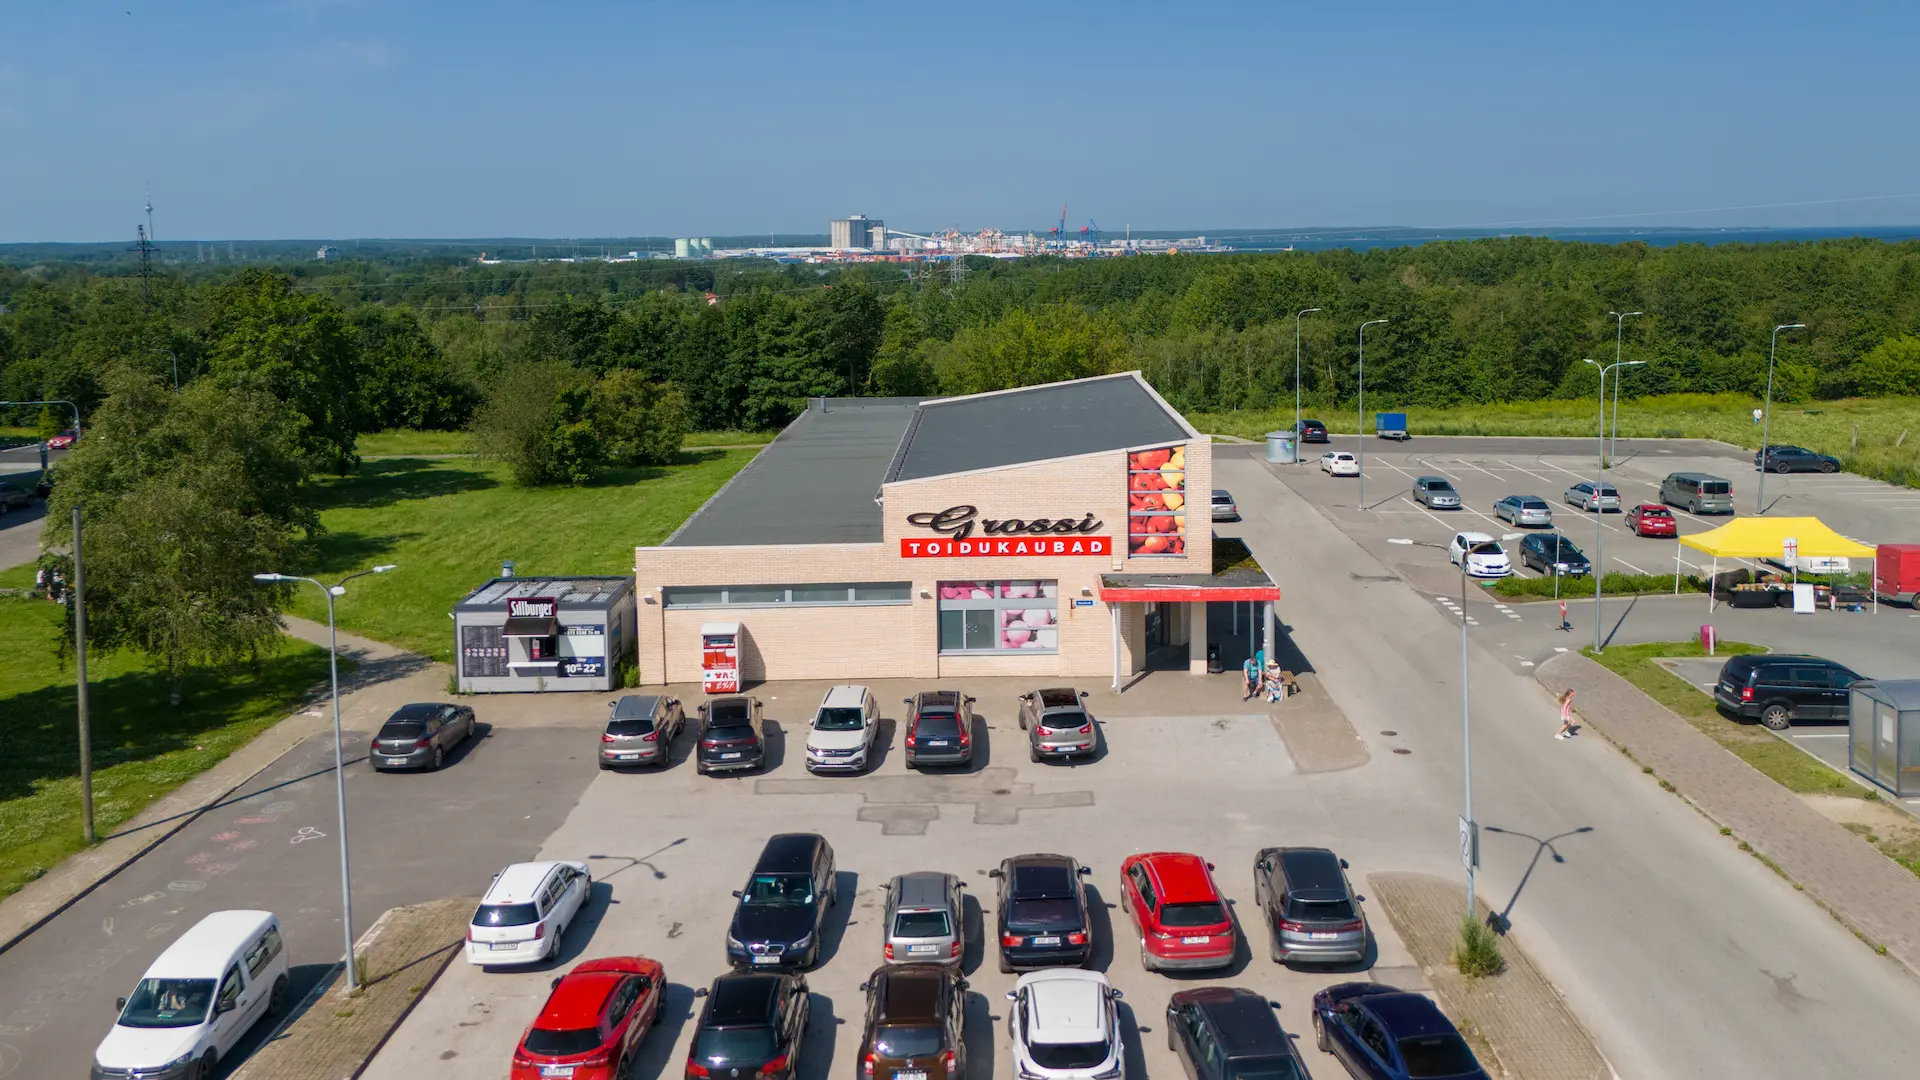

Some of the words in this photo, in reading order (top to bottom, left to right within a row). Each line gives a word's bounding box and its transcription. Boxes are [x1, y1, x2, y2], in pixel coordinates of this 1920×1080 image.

[906, 504, 1103, 542] Grossi
[909, 541, 1103, 555] TOIDUKAUBAD
[510, 600, 553, 618] Sillburger
